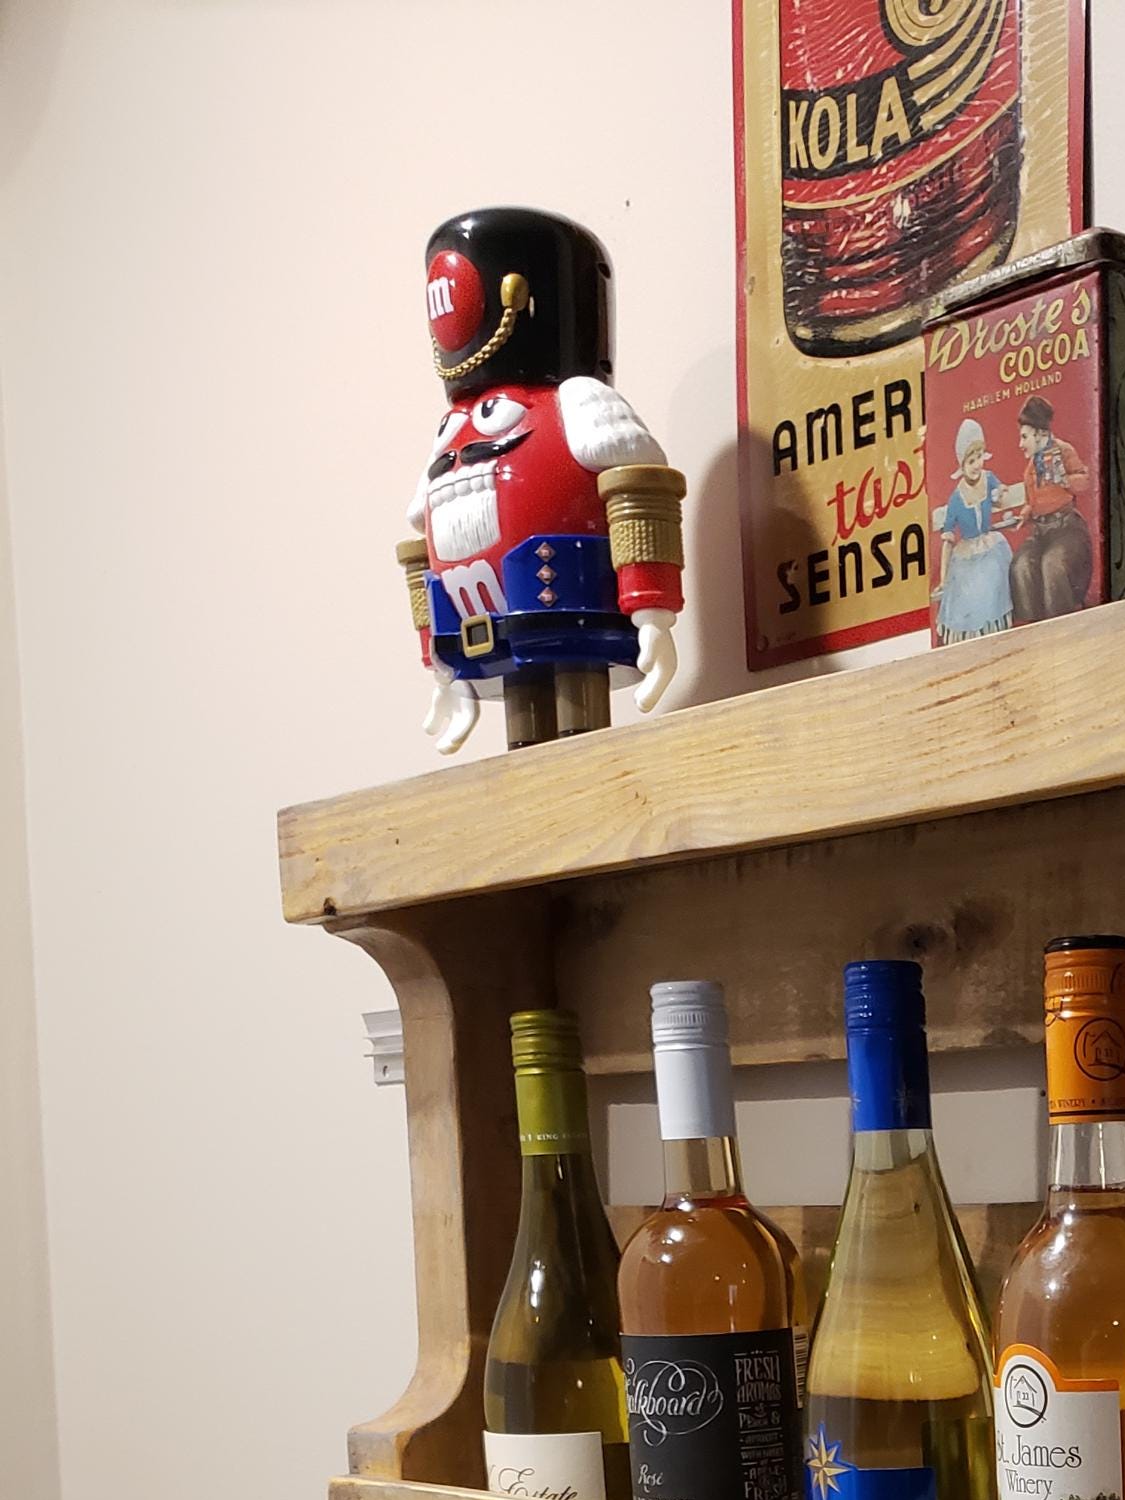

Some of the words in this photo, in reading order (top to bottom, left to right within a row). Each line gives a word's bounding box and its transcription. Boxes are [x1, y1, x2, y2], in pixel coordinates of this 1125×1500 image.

[789, 76, 911, 170] KOLA
[928, 280, 1091, 373] Droste's
[1000, 328, 1090, 383] COCOA
[962, 388, 1011, 413] HAARLEM
[1015, 371, 1063, 396] HOLLAND
[776, 523, 926, 615] SENSA
[734, 1355, 780, 1387] FRESH
[1012, 1434, 1082, 1468] James
